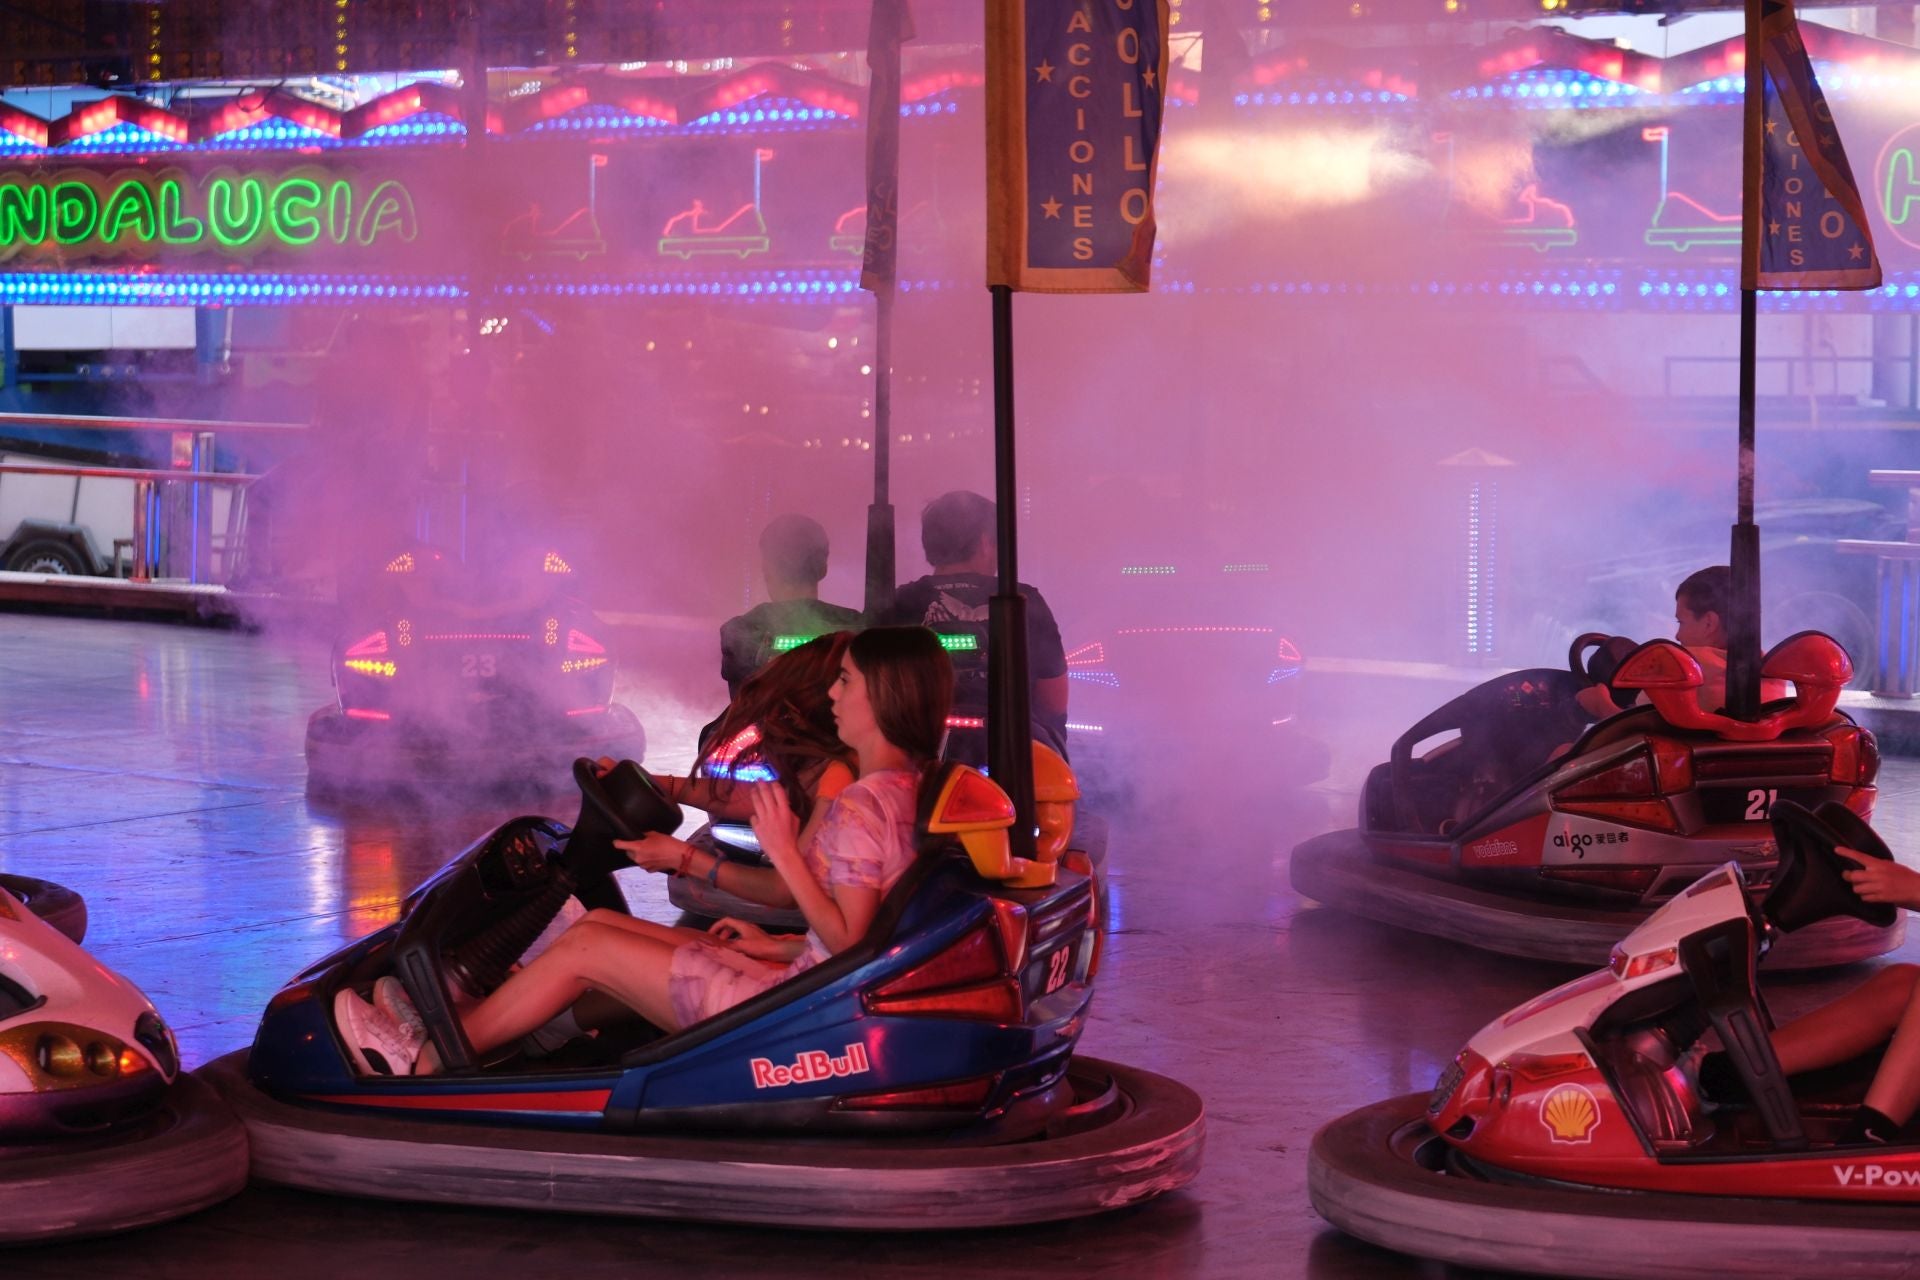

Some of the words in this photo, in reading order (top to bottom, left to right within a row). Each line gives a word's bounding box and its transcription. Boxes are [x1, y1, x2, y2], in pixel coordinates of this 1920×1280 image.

[1117, 0, 1149, 224] OLLO
[1067, 11, 1094, 259] ACCIONES
[461, 654, 497, 678] 23
[1473, 840, 1518, 858] vodafone
[1553, 830, 1593, 859] aigo
[1046, 944, 1070, 994] 22
